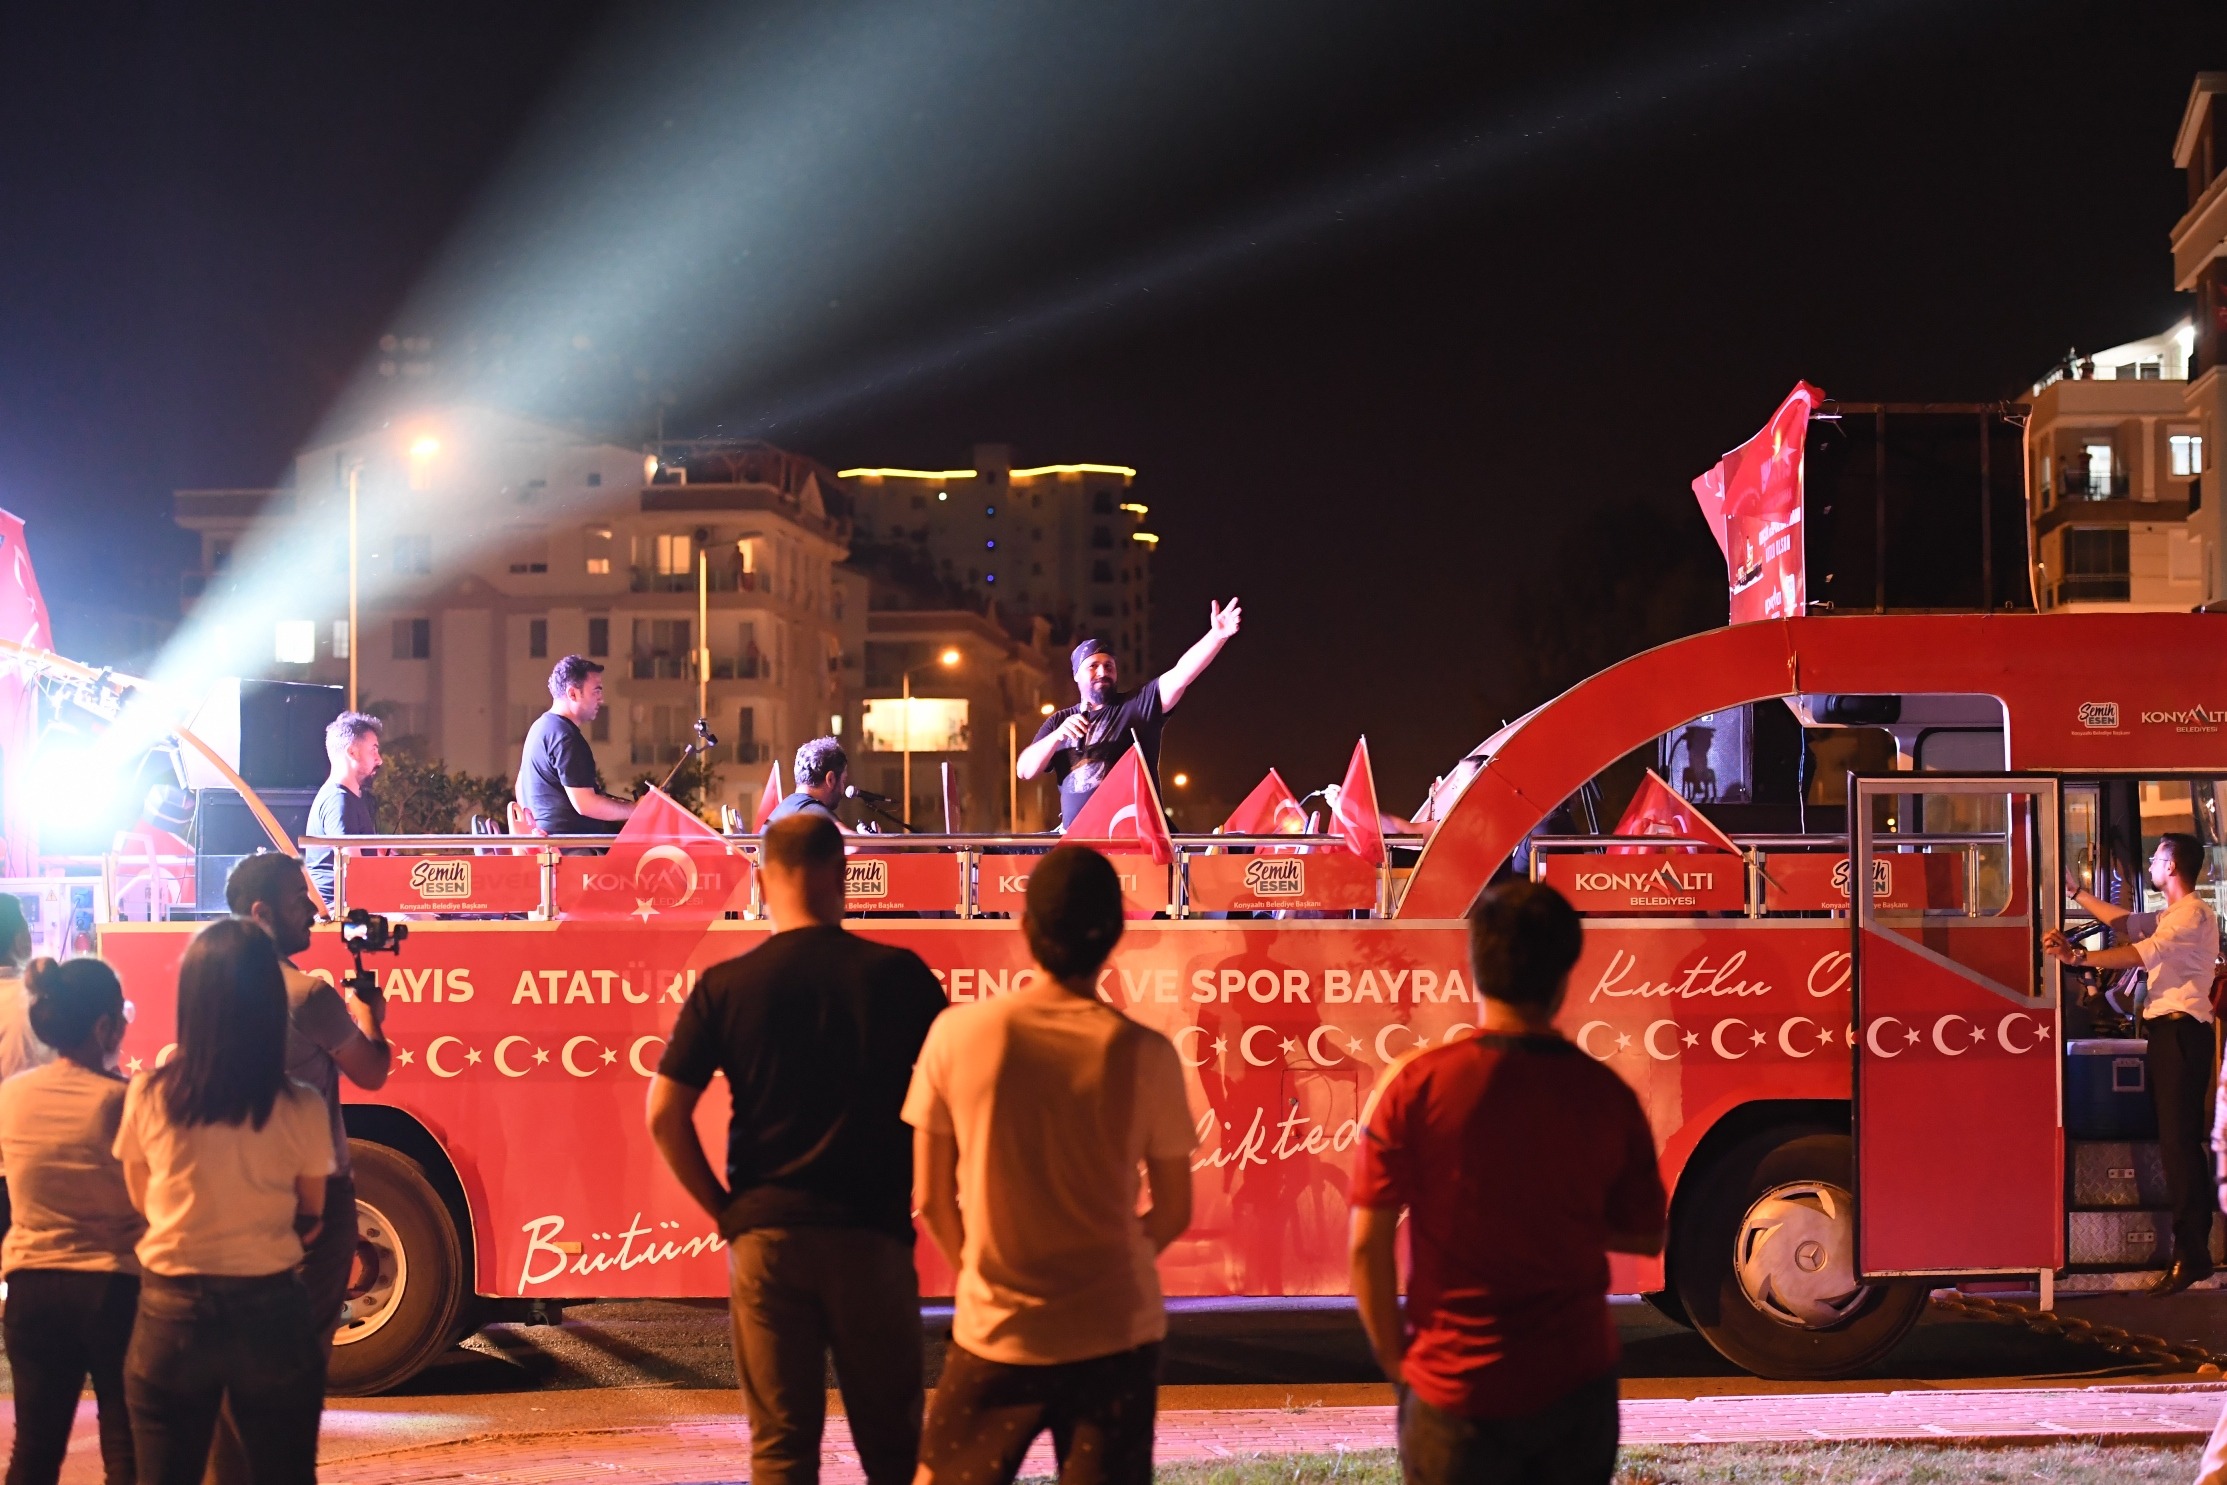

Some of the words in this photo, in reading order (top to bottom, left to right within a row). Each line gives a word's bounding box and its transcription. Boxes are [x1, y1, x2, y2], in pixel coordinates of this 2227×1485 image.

[2079, 703, 2115, 720] Semih
[2088, 717, 2115, 725] ESEN
[412, 862, 466, 887] Semih
[845, 862, 881, 881] emih
[1246, 860, 1299, 886] Semih
[1834, 861, 1886, 886] Sih
[425, 882, 465, 893] ESEN
[1260, 881, 1299, 891] ESEN
[849, 902, 877, 910] Belediye
[878, 902, 905, 910] Başkanı
[1233, 901, 1265, 909] Konyaaltı
[1266, 901, 1294, 909] Belediye
[1295, 900, 1322, 908] Başkanı
[1630, 897, 1696, 906] BELEDİYESİ
[511, 961, 697, 1005] ATATÜR
[1123, 968, 1179, 1003] VE
[1190, 969, 1312, 1004] SPOR
[1324, 969, 1480, 1004] BAYRA
[1589, 950, 1772, 1003] Kutlu
[517, 1212, 728, 1296] Bütün
